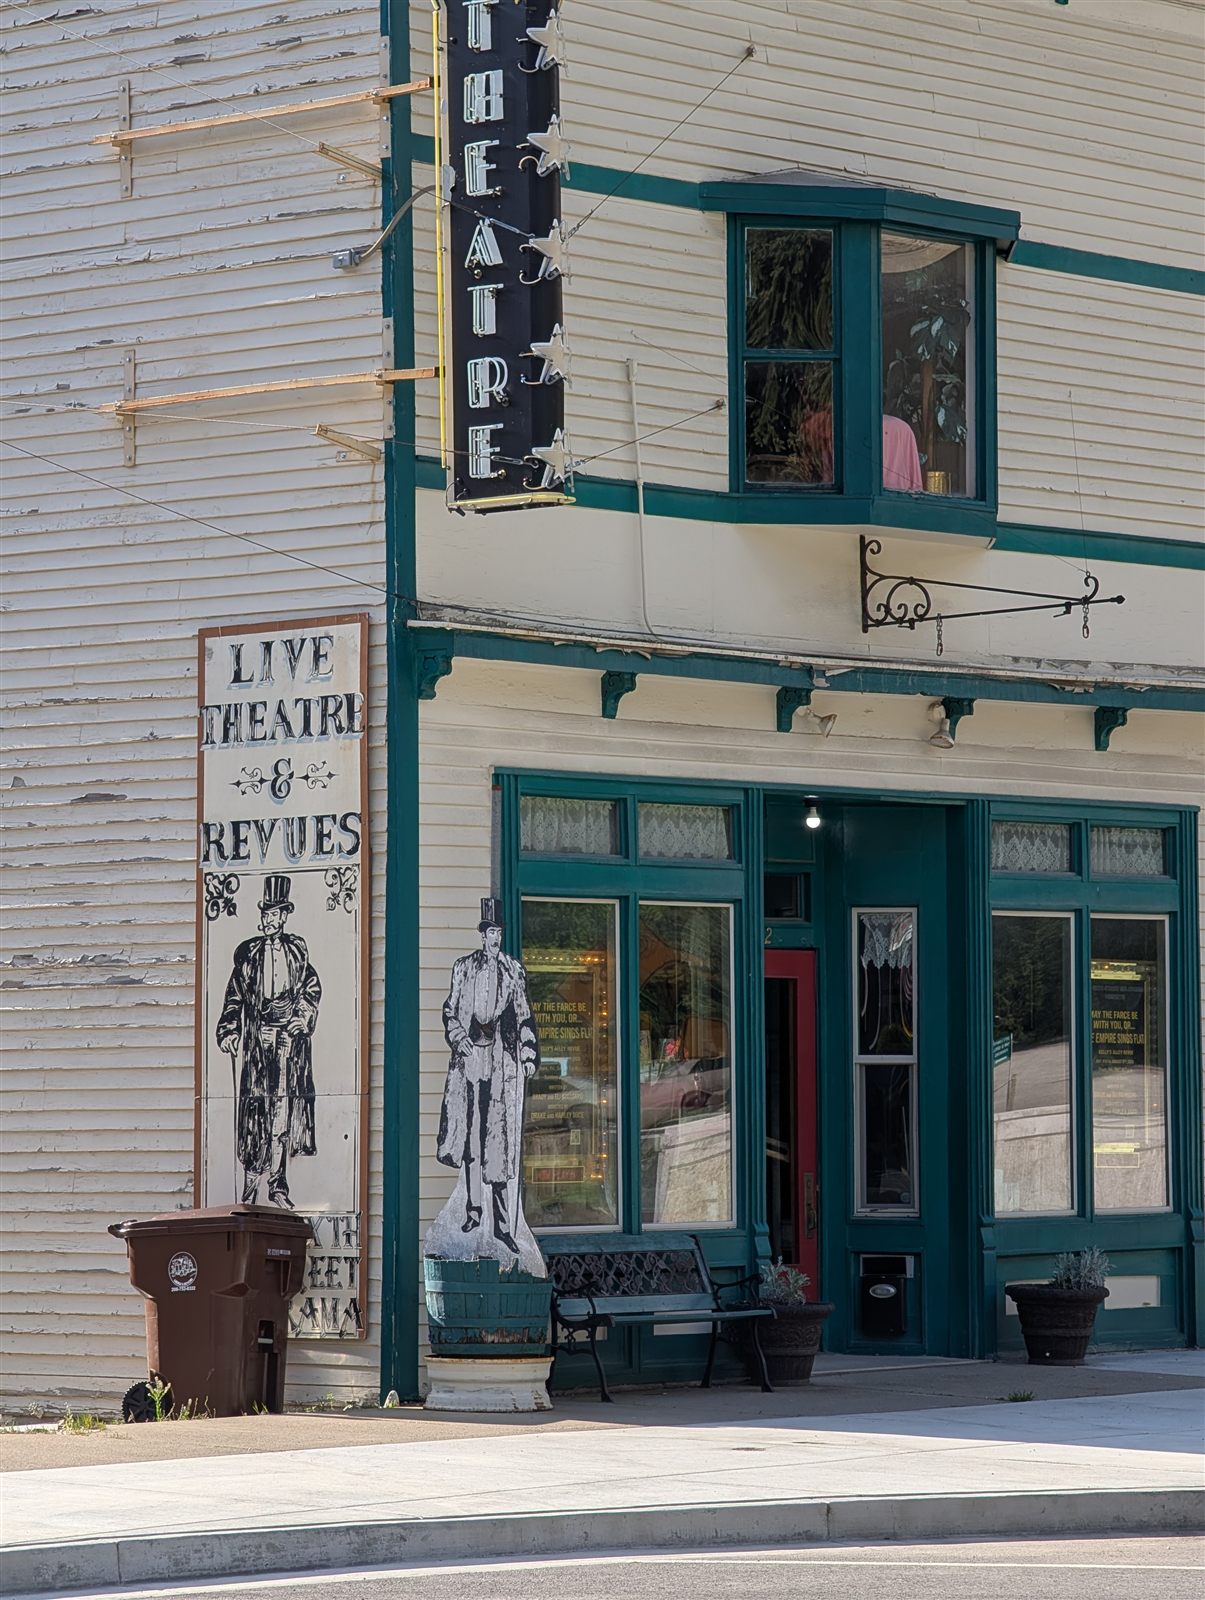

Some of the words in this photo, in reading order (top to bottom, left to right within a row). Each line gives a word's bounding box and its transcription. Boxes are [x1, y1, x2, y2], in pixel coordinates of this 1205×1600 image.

[462, 0, 508, 480] THEATRE
[228, 635, 335, 689] LIVE
[200, 692, 365, 750] THEATRE
[270, 758, 295, 804] &
[199, 812, 362, 867] REVUES
[543, 1002, 555, 1012] THE
[557, 1002, 576, 1012] FARCE
[578, 1002, 587, 1012] BE
[1102, 1010, 1112, 1019] THE
[1113, 1010, 1130, 1020] FARCE
[1131, 1011, 1138, 1020] BE
[560, 1027, 580, 1039] SINGS
[1093, 1020, 1109, 1029] WITH
[1095, 1032, 1116, 1044] EMPIRE
[1117, 1033, 1133, 1044] SINGS
